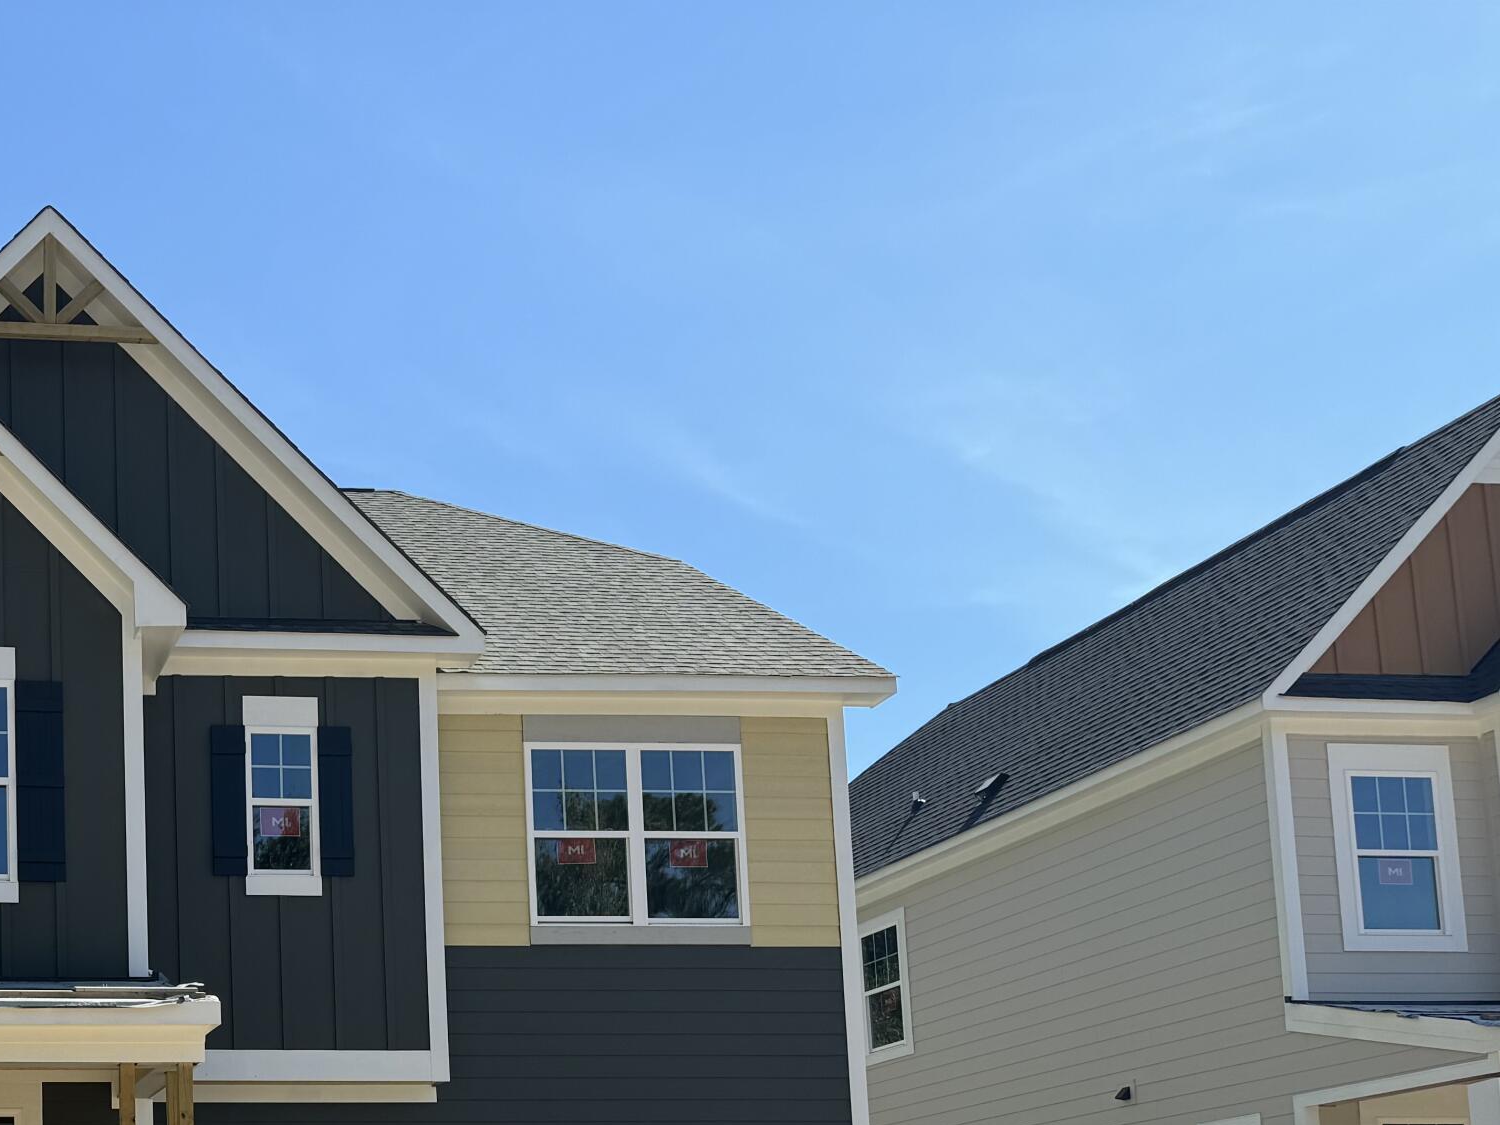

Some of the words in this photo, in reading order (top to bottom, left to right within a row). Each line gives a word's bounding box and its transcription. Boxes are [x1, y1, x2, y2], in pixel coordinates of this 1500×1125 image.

[567, 845, 585, 855] MI
[679, 848, 698, 859] MI
[1387, 866, 1403, 877] MI
